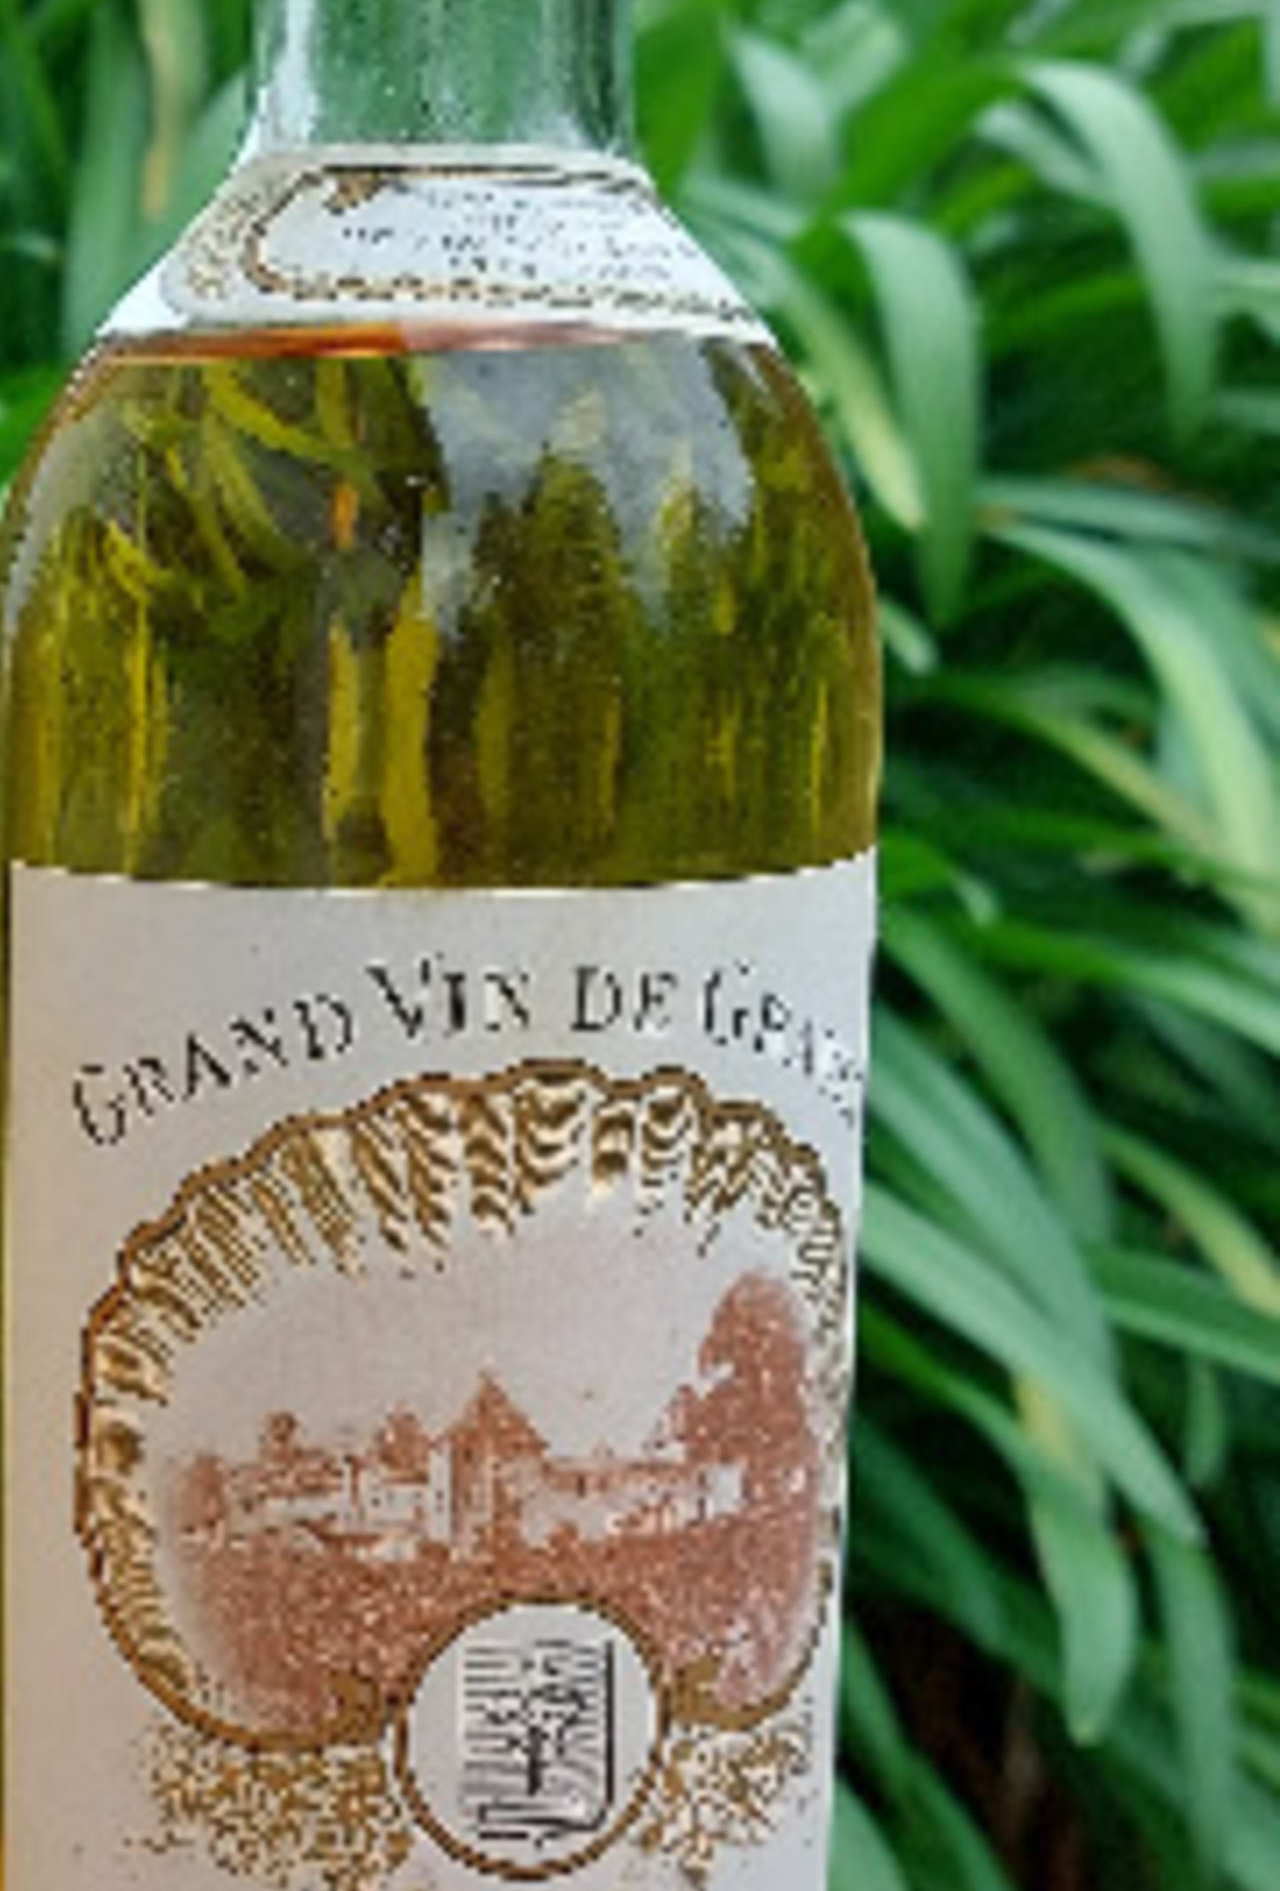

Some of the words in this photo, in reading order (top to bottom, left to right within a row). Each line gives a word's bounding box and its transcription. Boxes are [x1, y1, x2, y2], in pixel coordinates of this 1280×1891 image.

[73, 993, 352, 1146] GRAND
[366, 953, 530, 1039] VIN
[571, 965, 677, 1032] DE
